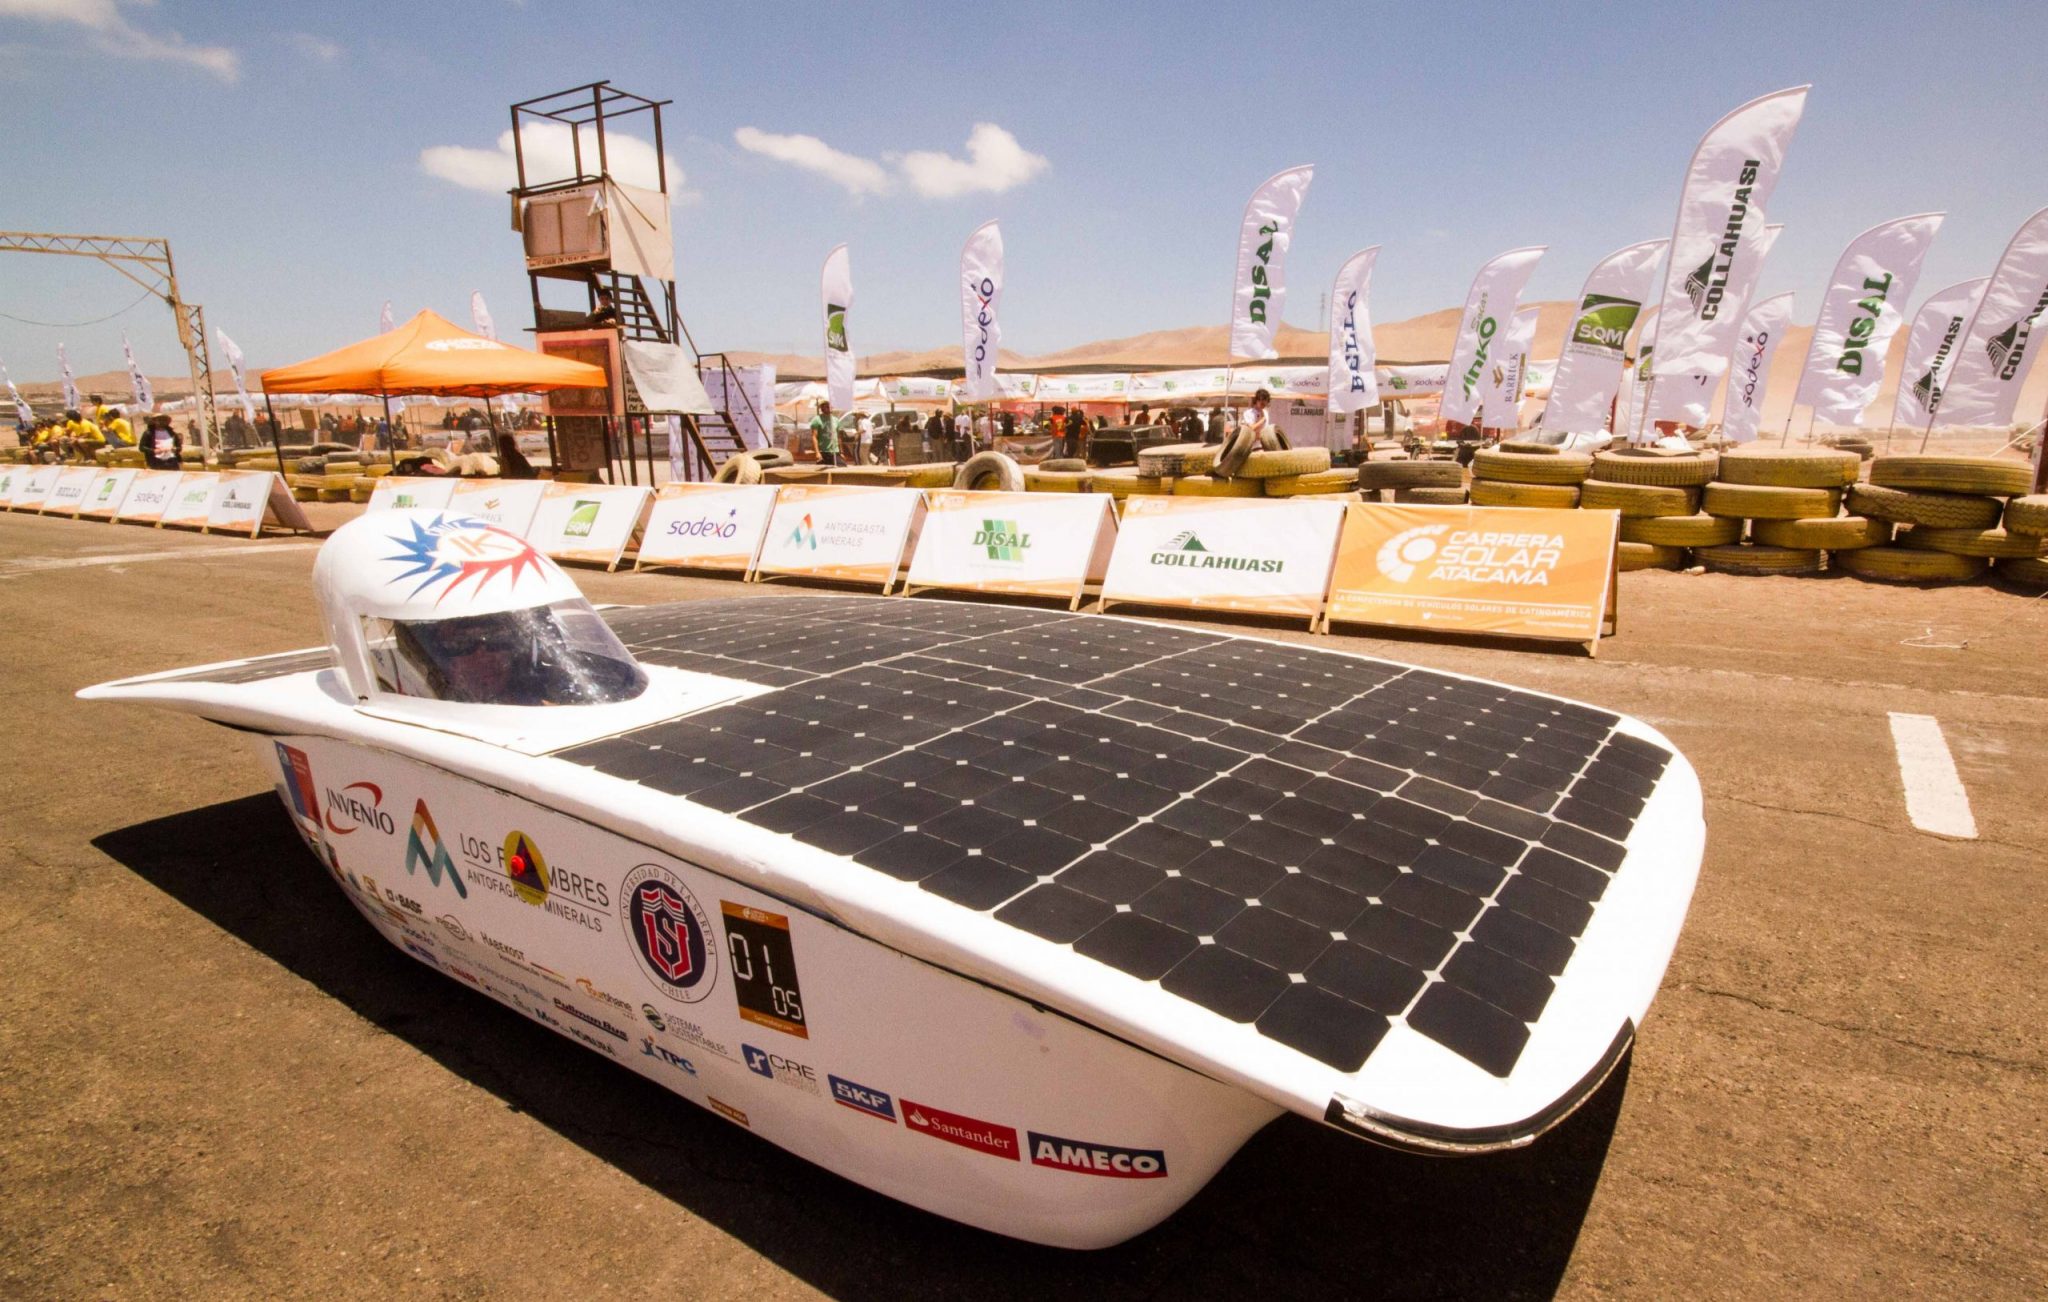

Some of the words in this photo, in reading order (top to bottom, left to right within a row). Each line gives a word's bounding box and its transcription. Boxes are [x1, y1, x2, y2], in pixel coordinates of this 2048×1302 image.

[1701, 159, 1761, 321] COLLAHUASI
[1249, 220, 1279, 325] DISAL
[1578, 324, 1625, 345] SQM
[1837, 272, 1893, 377] DISAL
[1505, 353, 1519, 402] BARRICK
[1743, 331, 1769, 408] sodexo
[667, 516, 737, 538] sodexo
[820, 535, 864, 548] MINERALS
[824, 521, 886, 535] ANTOFAGASTA
[972, 530, 1032, 549] DISAL
[1448, 530, 1565, 549] CARRERA
[1150, 552, 1284, 574] COLLAHUASI
[1436, 545, 1561, 570] SOLAR
[1427, 567, 1548, 586] ATACAMA
[1505, 606, 1516, 615] DE
[326, 787, 395, 835] INVENIO
[459, 833, 492, 864] LOS
[544, 900, 603, 933] MINERALS
[623, 868, 660, 920] UNIVERSIDAD
[664, 873, 677, 887] DE
[679, 887, 691, 901] LA
[691, 903, 715, 956] SERENA
[728, 932, 774, 985] 01
[661, 982, 691, 1000] CHILE
[772, 985, 803, 1020] 05
[553, 997, 602, 1026] Pullman
[602, 1019, 628, 1039] Bus
[664, 1012, 704, 1037] SISTEMAS
[655, 1045, 697, 1075] TPC
[769, 1053, 817, 1082] CRE
[836, 1082, 886, 1109] SKF
[931, 1116, 1010, 1150] Santander
[1035, 1140, 1160, 1174] AMECO
